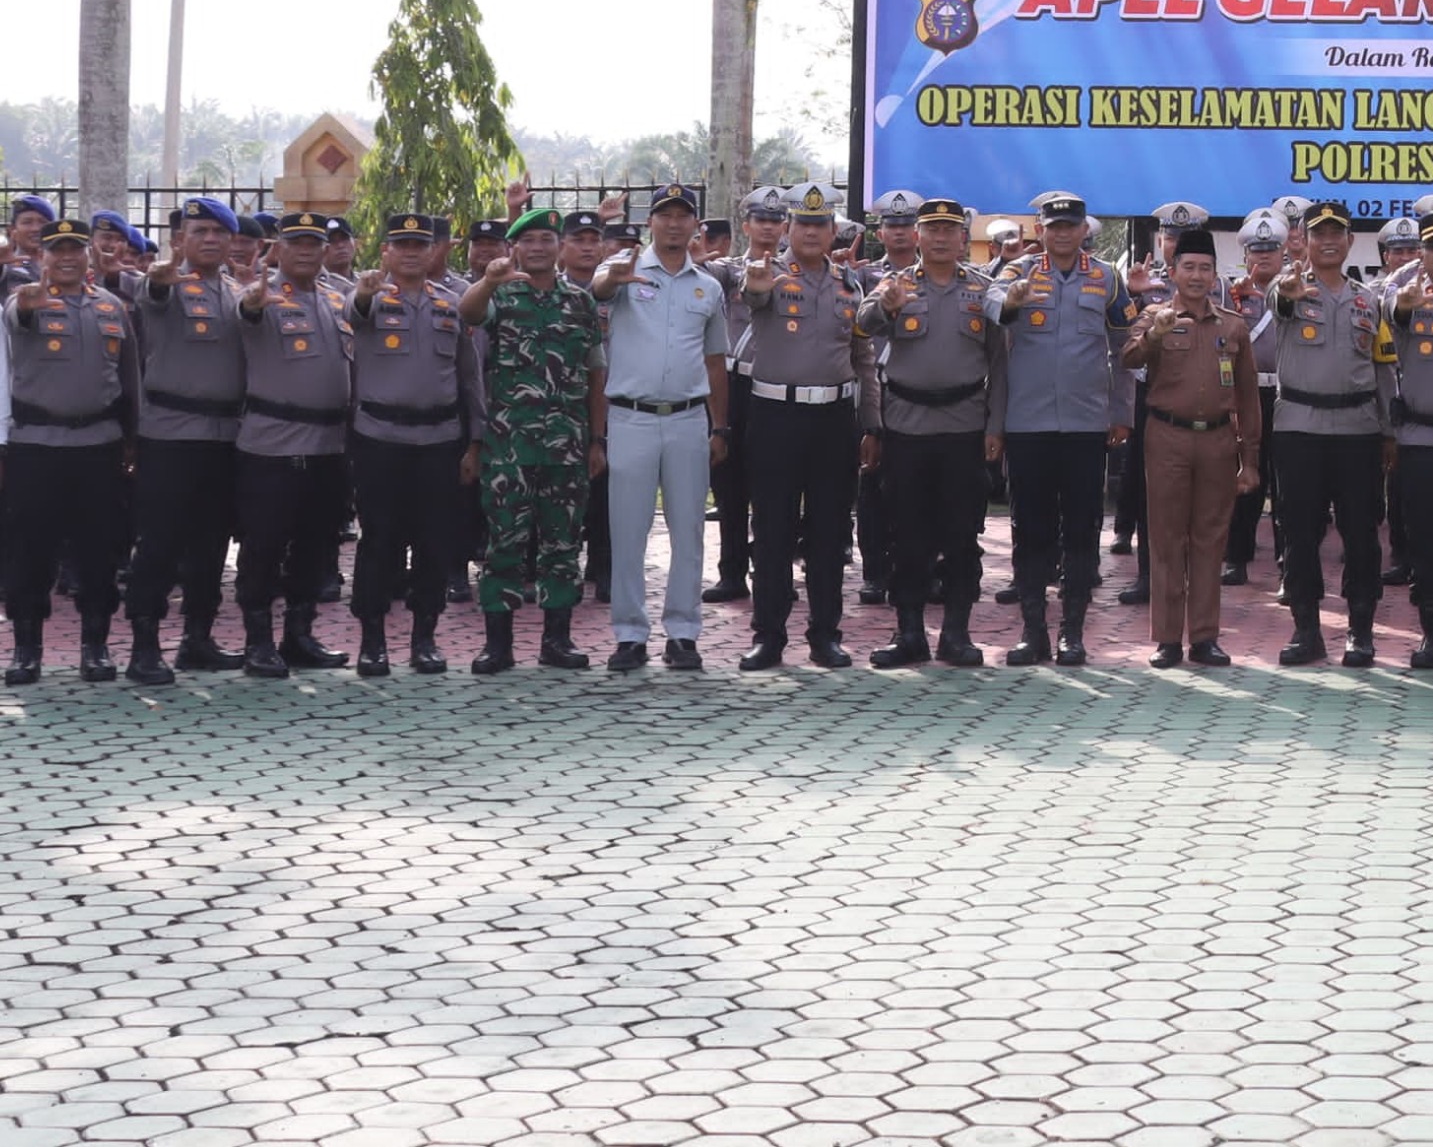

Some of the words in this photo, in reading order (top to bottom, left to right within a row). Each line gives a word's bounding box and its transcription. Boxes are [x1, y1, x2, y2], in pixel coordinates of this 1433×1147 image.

[1325, 46, 1406, 67] Dalam
[916, 85, 1081, 128] OPERASI
[1089, 86, 1346, 130] KESELAMATAN
[1357, 200, 1383, 217] 02
